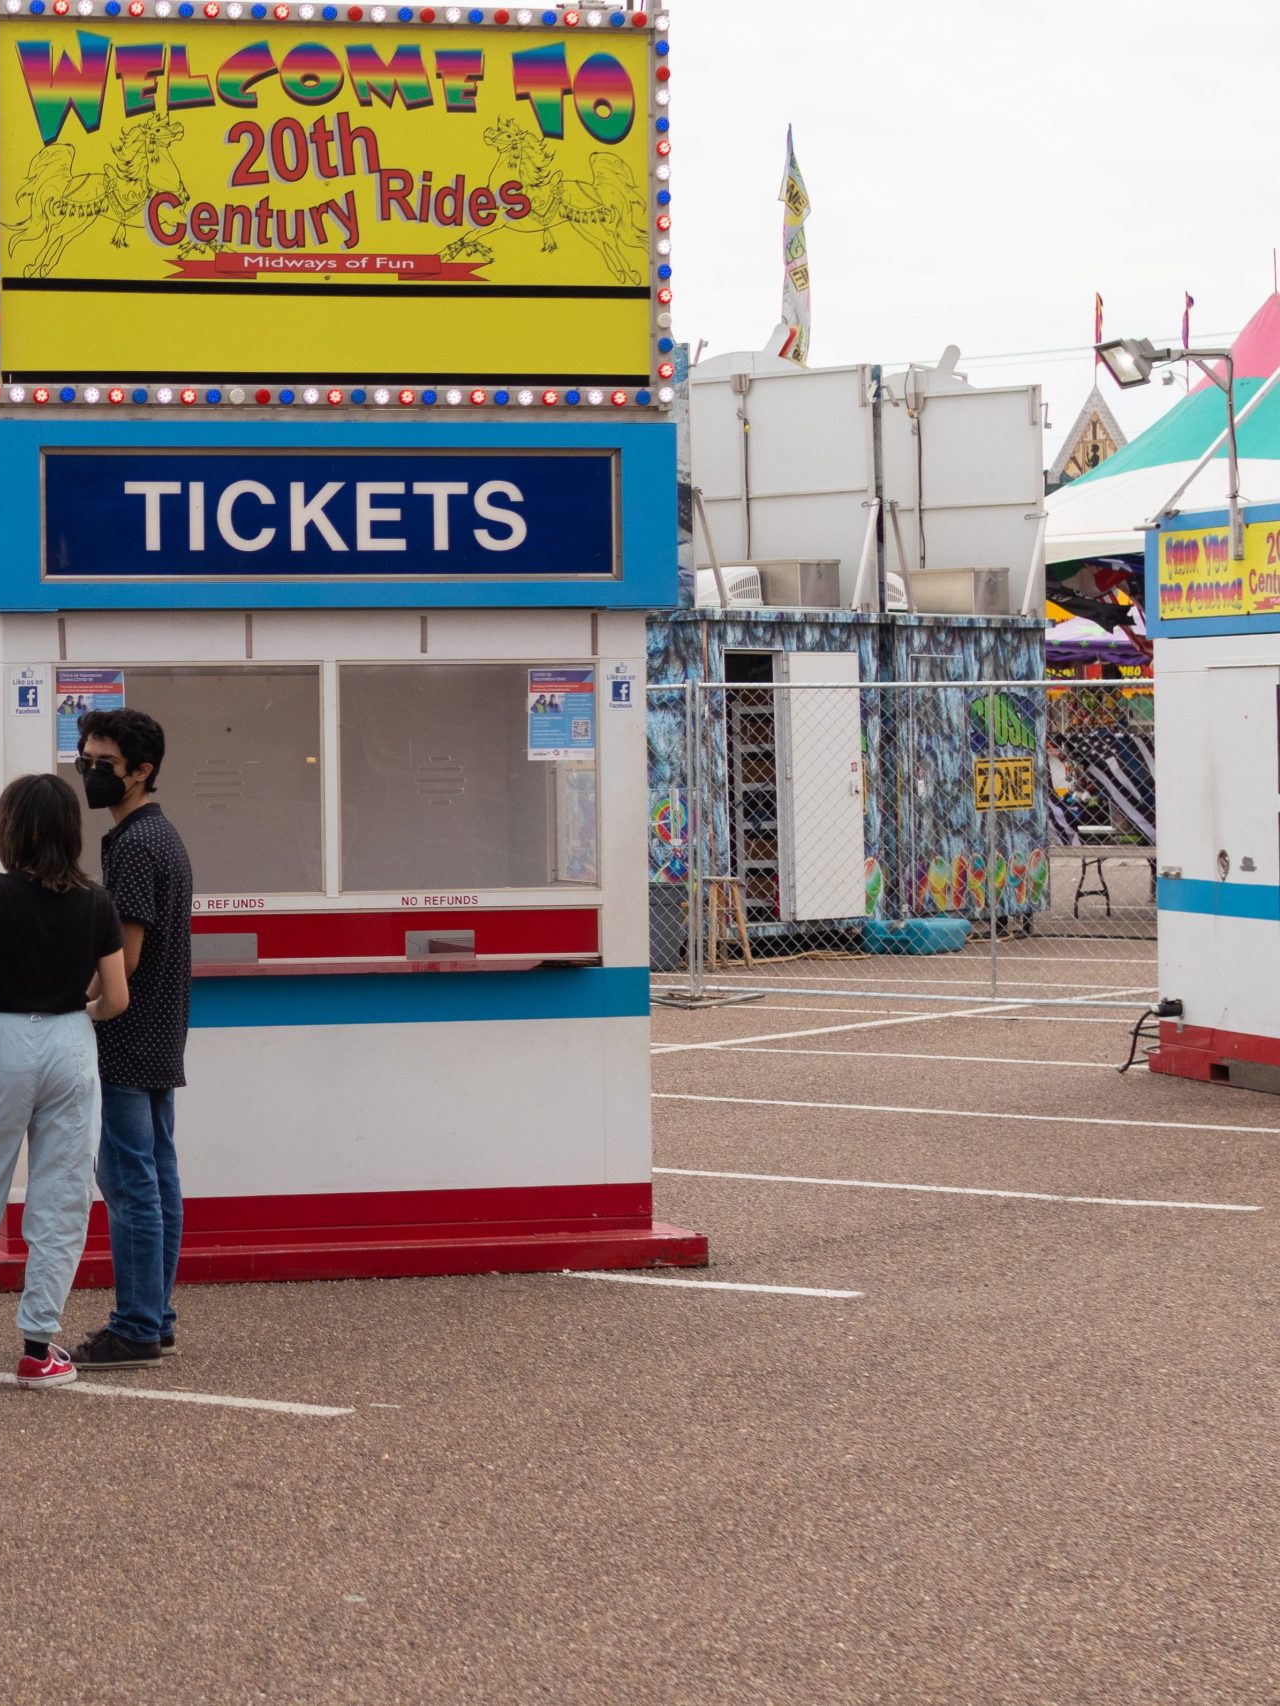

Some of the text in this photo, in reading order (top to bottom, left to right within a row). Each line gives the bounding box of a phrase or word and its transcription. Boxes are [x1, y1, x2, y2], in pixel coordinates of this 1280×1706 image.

[15, 29, 636, 146] WELCOME TO
[224, 111, 380, 189] 20th
[146, 167, 532, 251] Century Rides
[244, 256, 415, 272] Midways of Fun
[124, 479, 527, 552] TICKETS
[977, 766, 1031, 803] ZONE
[192, 900, 201, 910] O
[401, 895, 479, 906] NO REFUNDS
